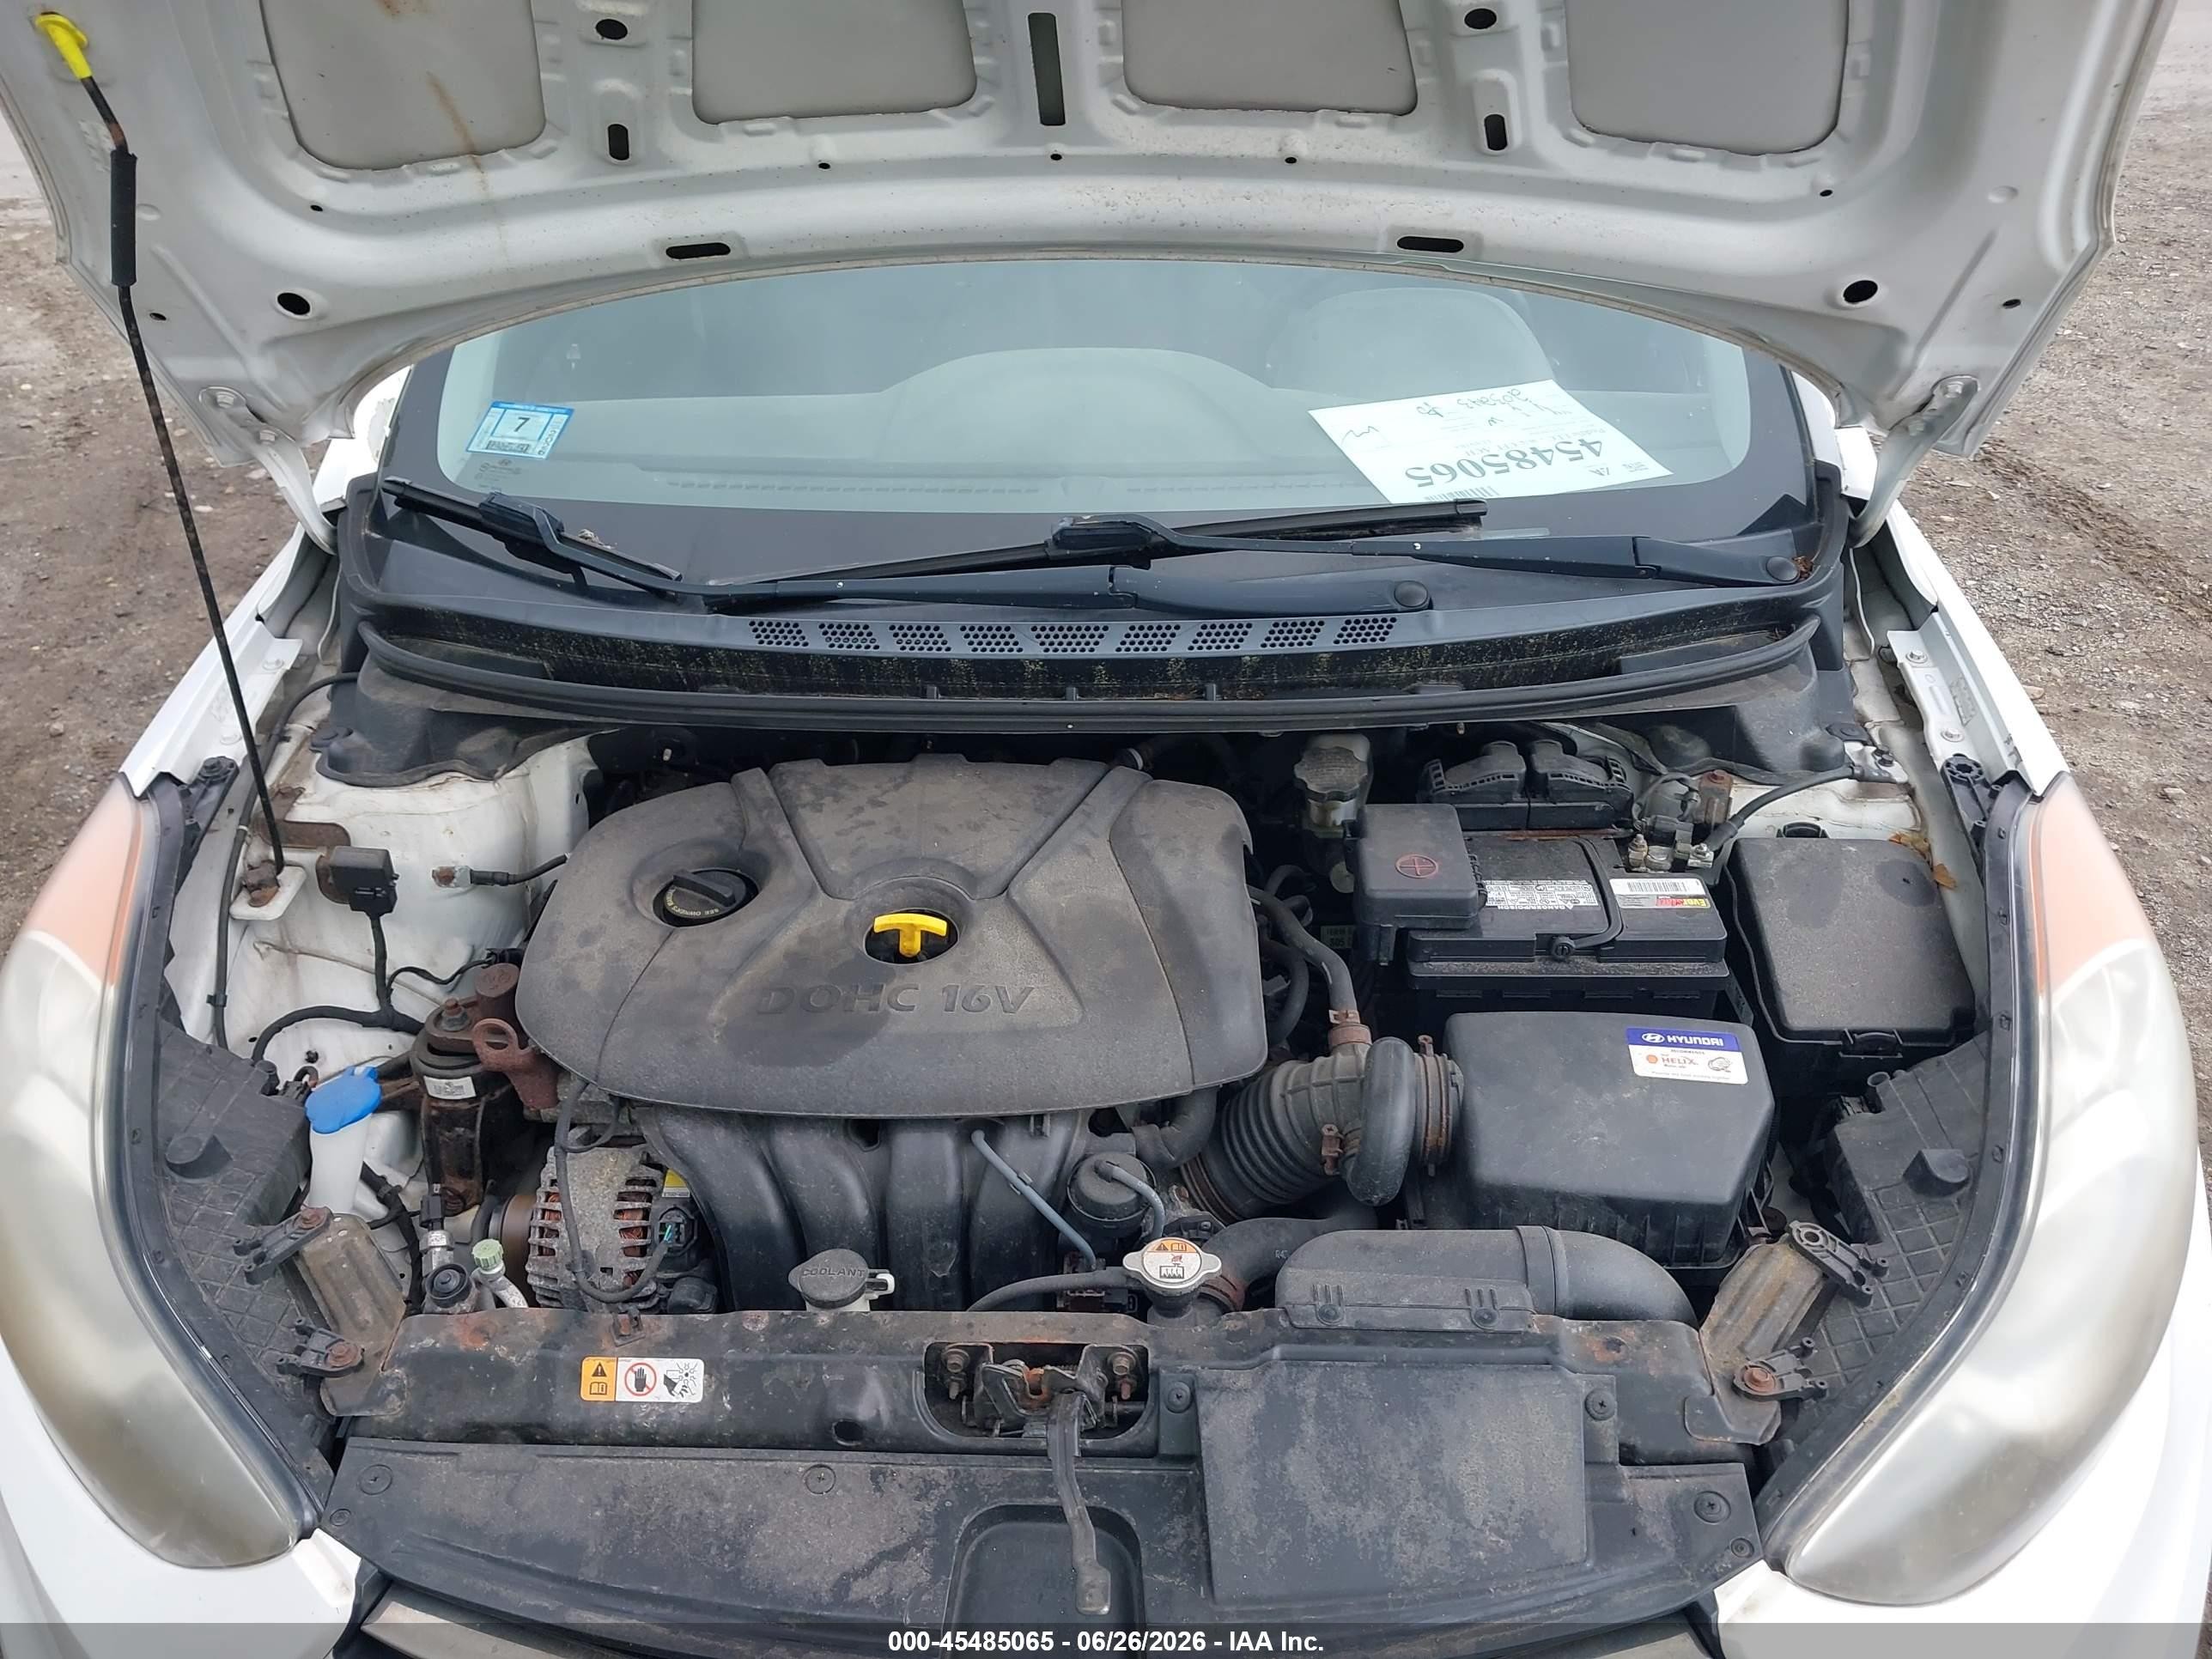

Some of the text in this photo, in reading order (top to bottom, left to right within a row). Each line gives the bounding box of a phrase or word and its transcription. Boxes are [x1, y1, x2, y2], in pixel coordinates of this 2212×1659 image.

[514, 416, 530, 432] 7
[1405, 439, 1603, 488] 45485065
[757, 983, 1036, 1015] DOHC 16V
[1667, 1034, 1724, 1047] HYUNDAI
[802, 1268, 866, 1279] COOLANT
